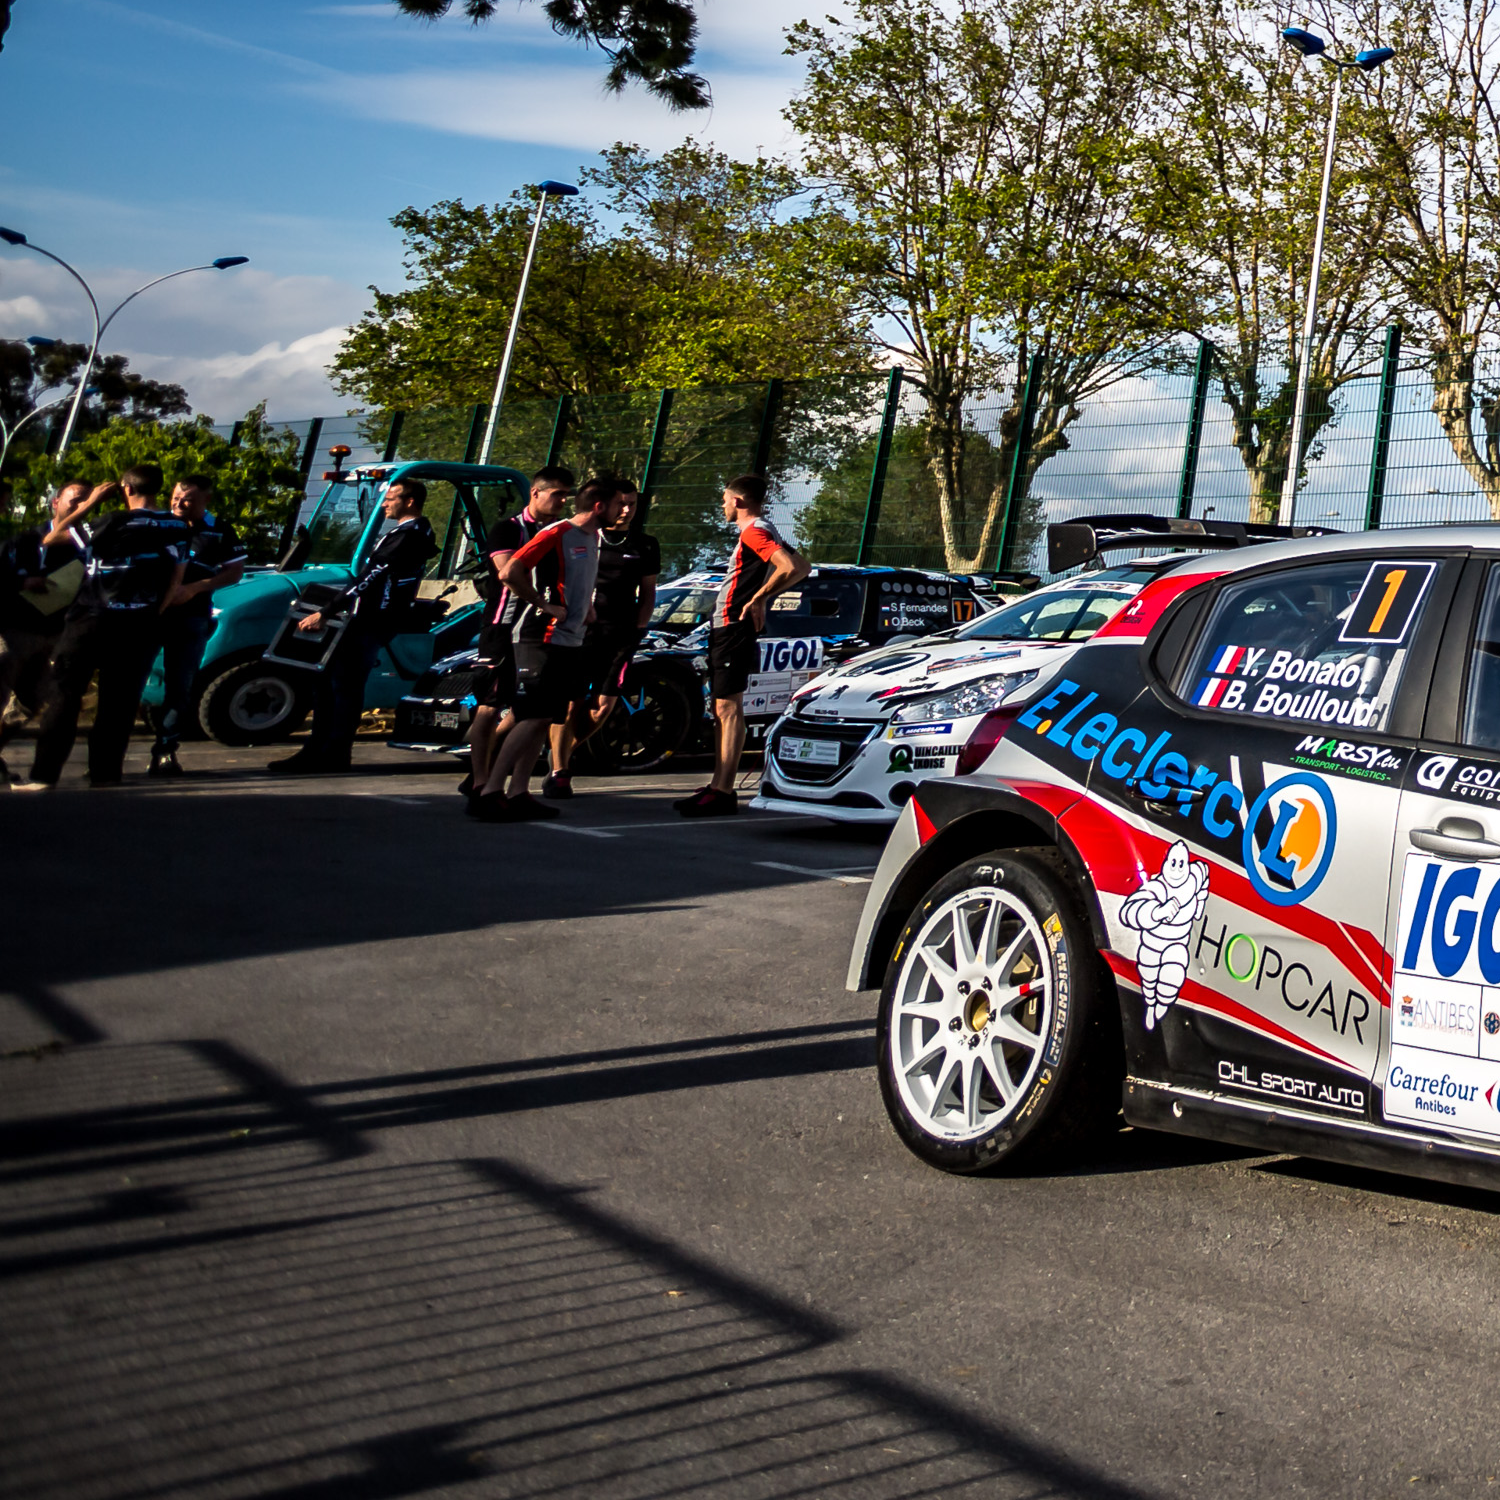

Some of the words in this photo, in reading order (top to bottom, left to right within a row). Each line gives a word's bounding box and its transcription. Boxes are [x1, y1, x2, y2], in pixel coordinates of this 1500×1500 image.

[346, 563, 389, 597] TOTAL
[953, 600, 973, 621] 17
[1367, 569, 1408, 633] 1
[762, 639, 820, 672] IGOL
[1241, 647, 1266, 676] Y.
[1266, 650, 1361, 688] Bonato
[1220, 680, 1247, 711] B.
[1253, 683, 1379, 727] Boulloud
[1016, 678, 1244, 839] E.Leclerc
[1293, 754, 1340, 772] TRANSPORT
[1345, 765, 1387, 782] LOGISTICS
[1194, 914, 1370, 1046] HOPCAR
[1413, 997, 1475, 1032] ANTIBES
[1217, 1060, 1259, 1086] CHL
[1260, 1072, 1318, 1098] SPORT
[1317, 1084, 1365, 1108] AUTO
[1390, 1065, 1479, 1102] Carrefour
[1415, 1096, 1457, 1116] Antibes
